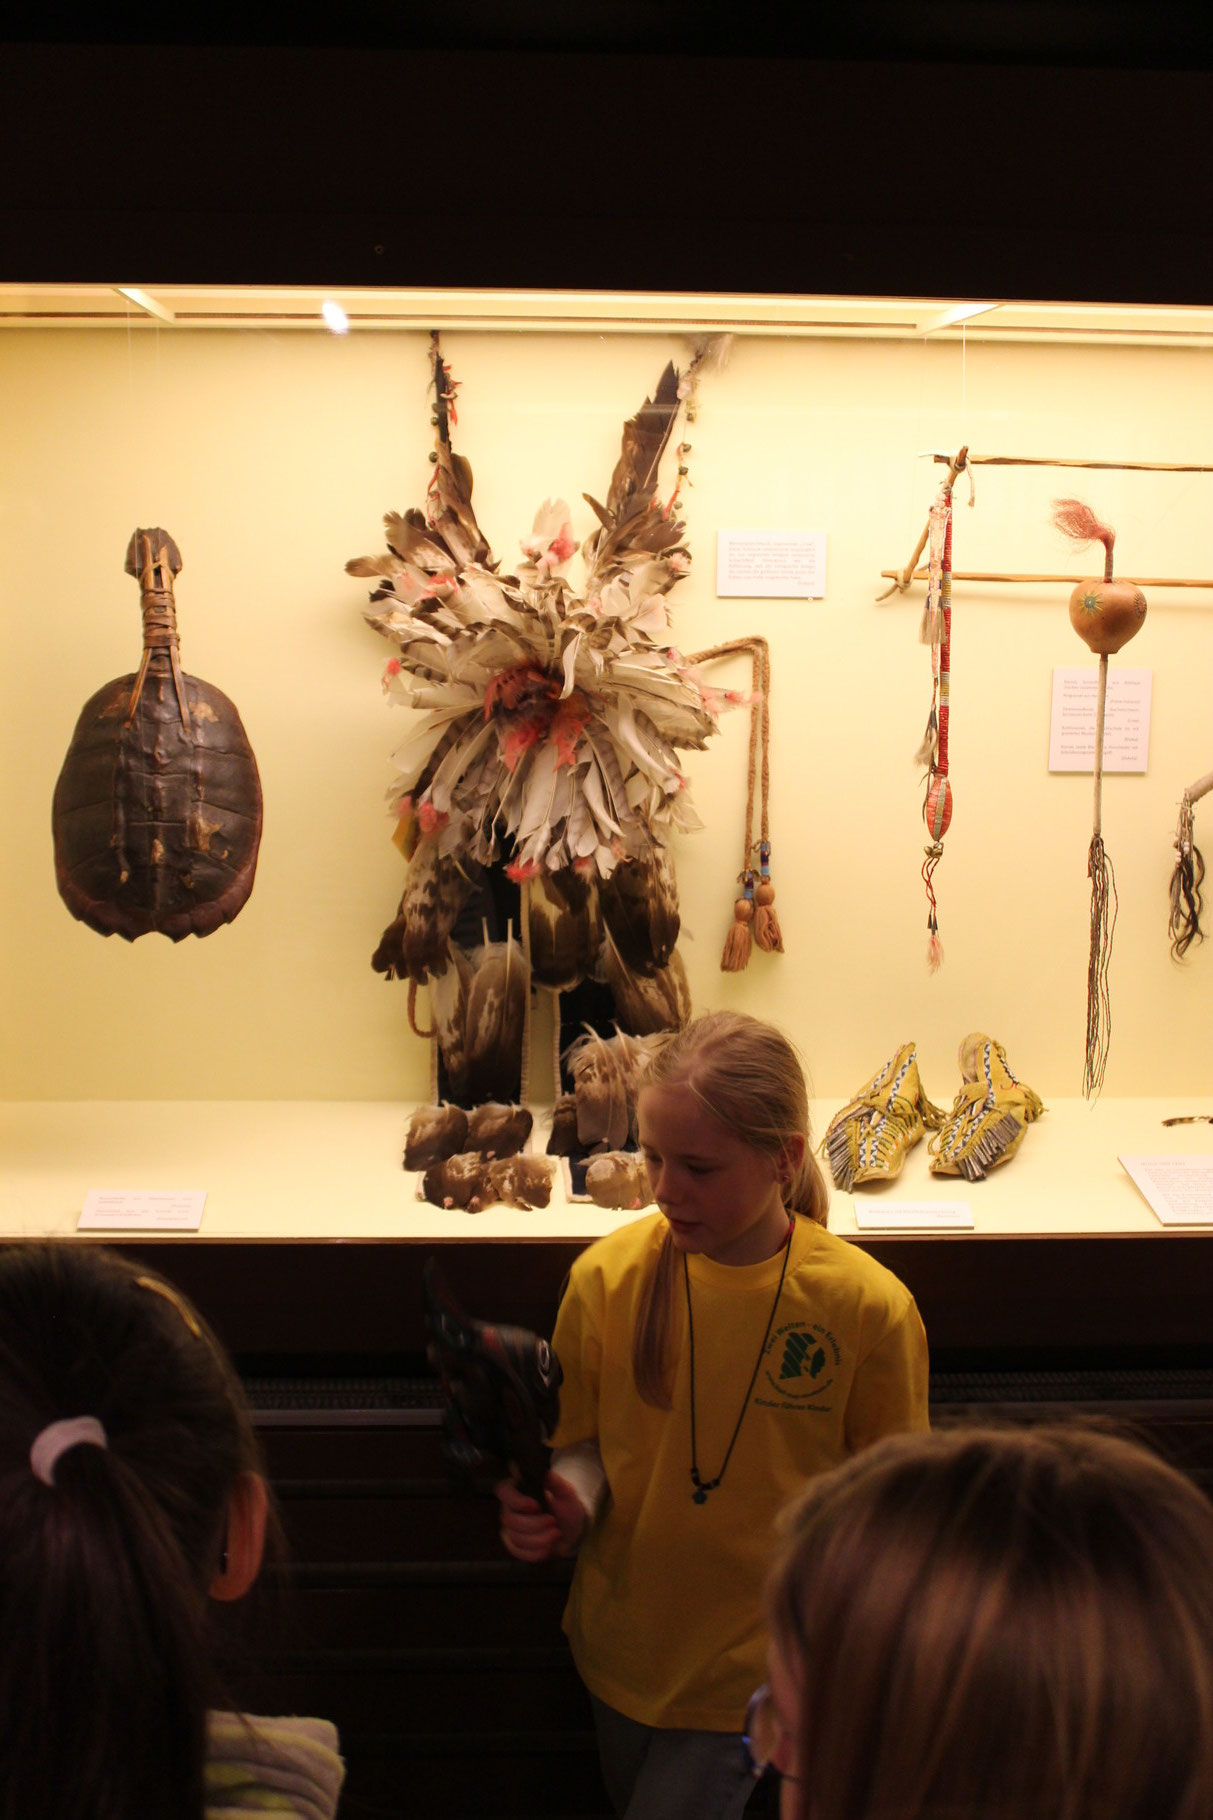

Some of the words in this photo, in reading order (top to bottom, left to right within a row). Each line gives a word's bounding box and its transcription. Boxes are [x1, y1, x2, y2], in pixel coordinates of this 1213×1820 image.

[777, 1321, 805, 1335] Welten
[826, 1332, 841, 1365] Erlebnis
[754, 1397, 780, 1408] Kinder
[807, 1404, 832, 1412] Kinder
